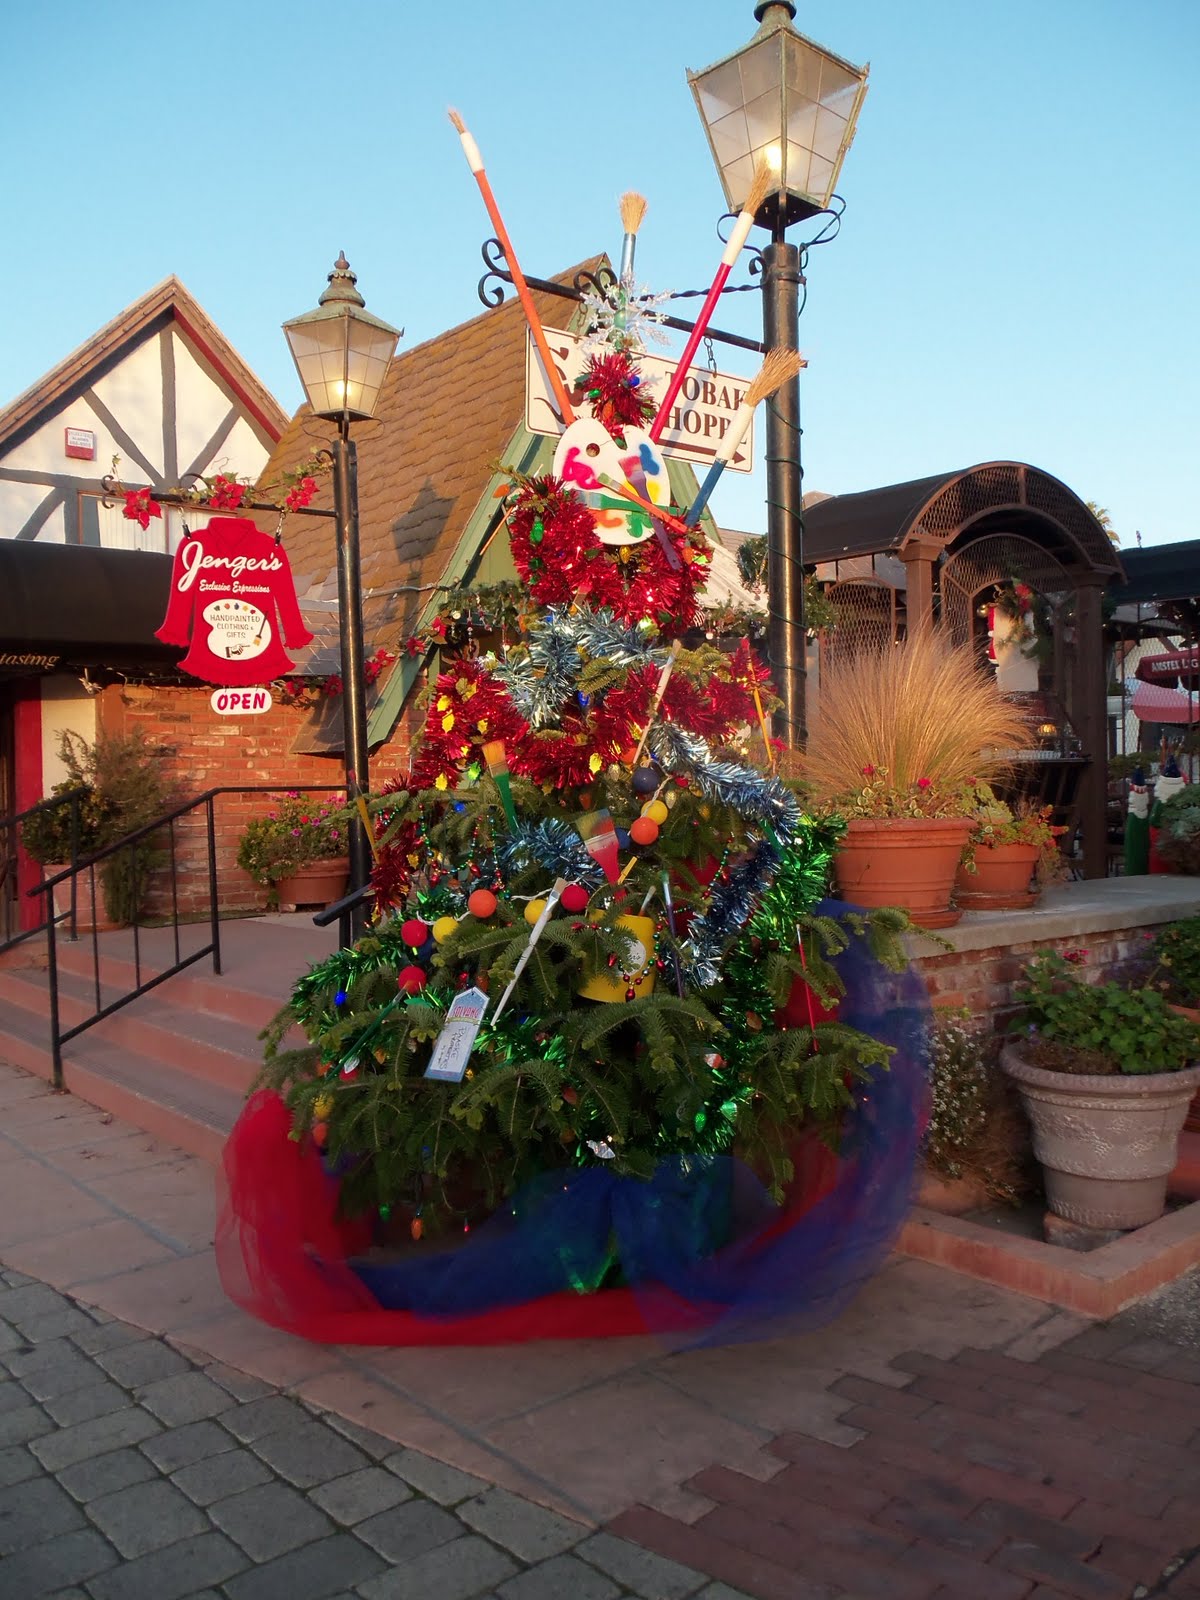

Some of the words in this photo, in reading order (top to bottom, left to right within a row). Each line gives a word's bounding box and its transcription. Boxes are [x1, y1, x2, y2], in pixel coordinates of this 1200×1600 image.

[657, 404, 748, 445] HOPP
[178, 541, 283, 592] Jenger's
[199, 579, 231, 592] Exclusive
[232, 581, 270, 594] Expressions
[210, 614, 261, 623] HANDPAINTED
[216, 622, 249, 631] CLOTHING
[226, 631, 246, 639] GIFTS
[1151, 660, 1180, 672] AMSTEL
[217, 693, 266, 711] OPEN
